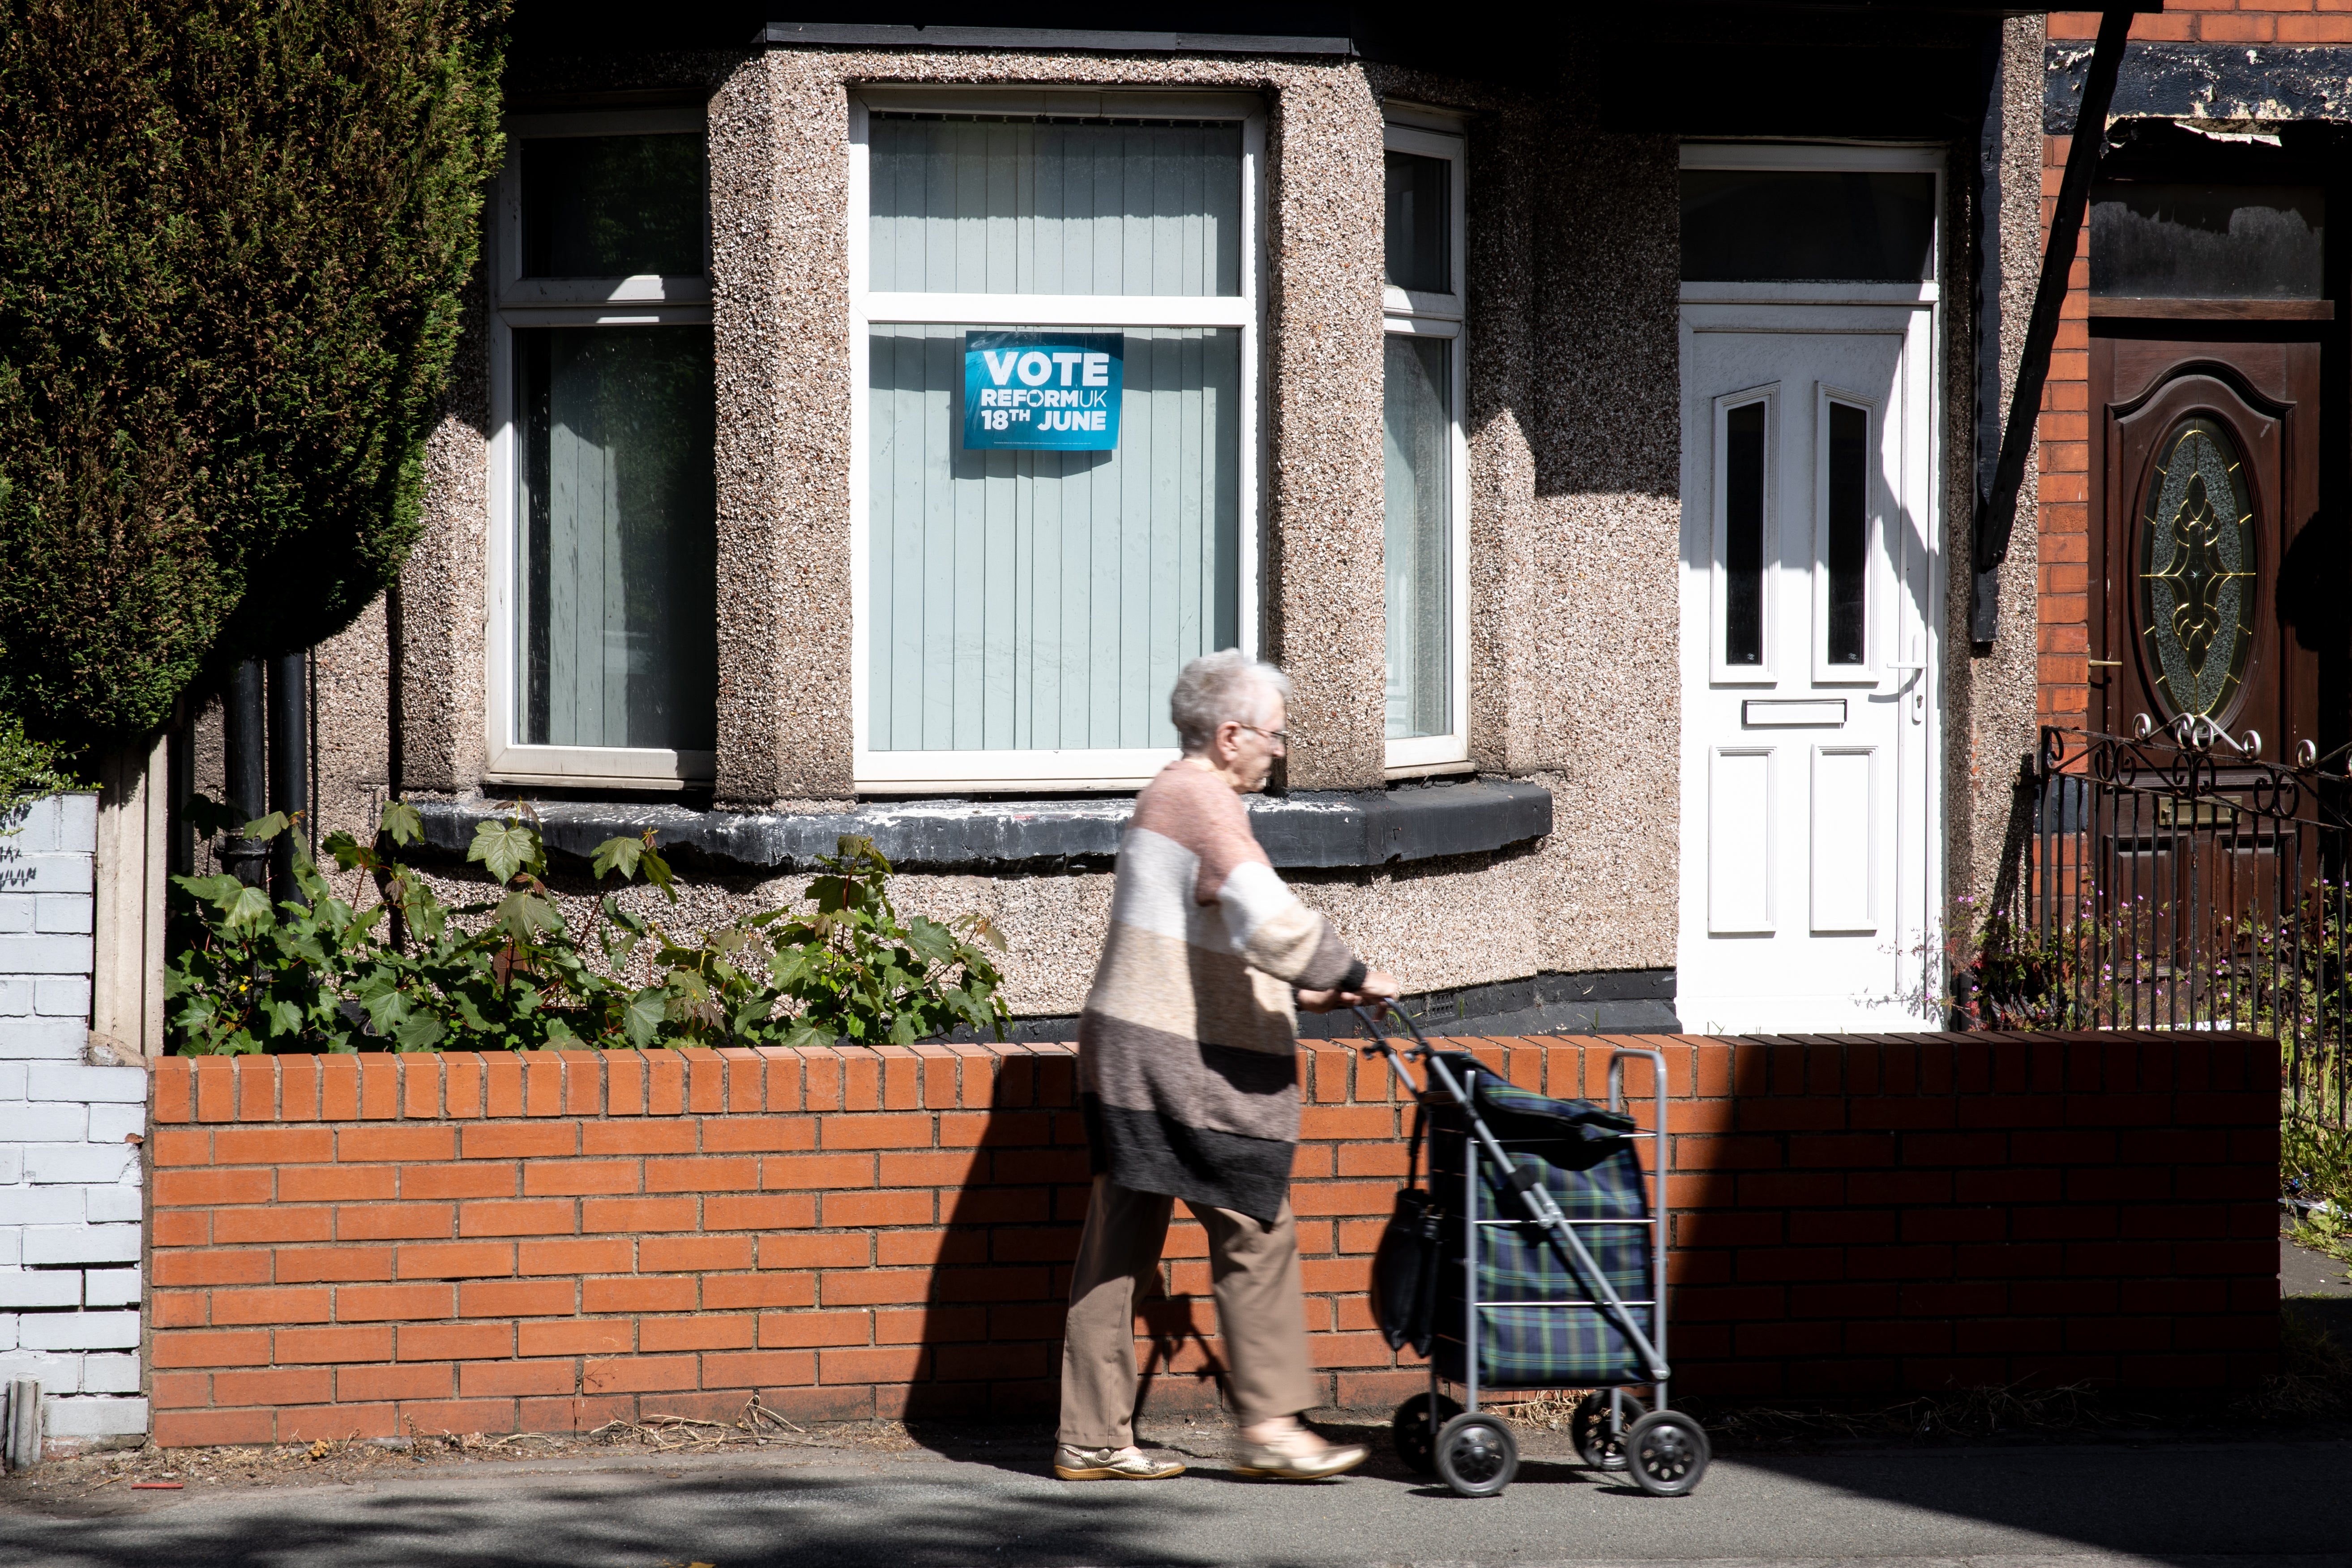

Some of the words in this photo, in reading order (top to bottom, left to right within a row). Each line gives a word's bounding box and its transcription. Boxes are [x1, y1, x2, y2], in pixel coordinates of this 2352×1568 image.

[983, 351, 1109, 386] VOTE
[981, 409, 1030, 430] 18TH
[1037, 410, 1107, 431] JUNE
